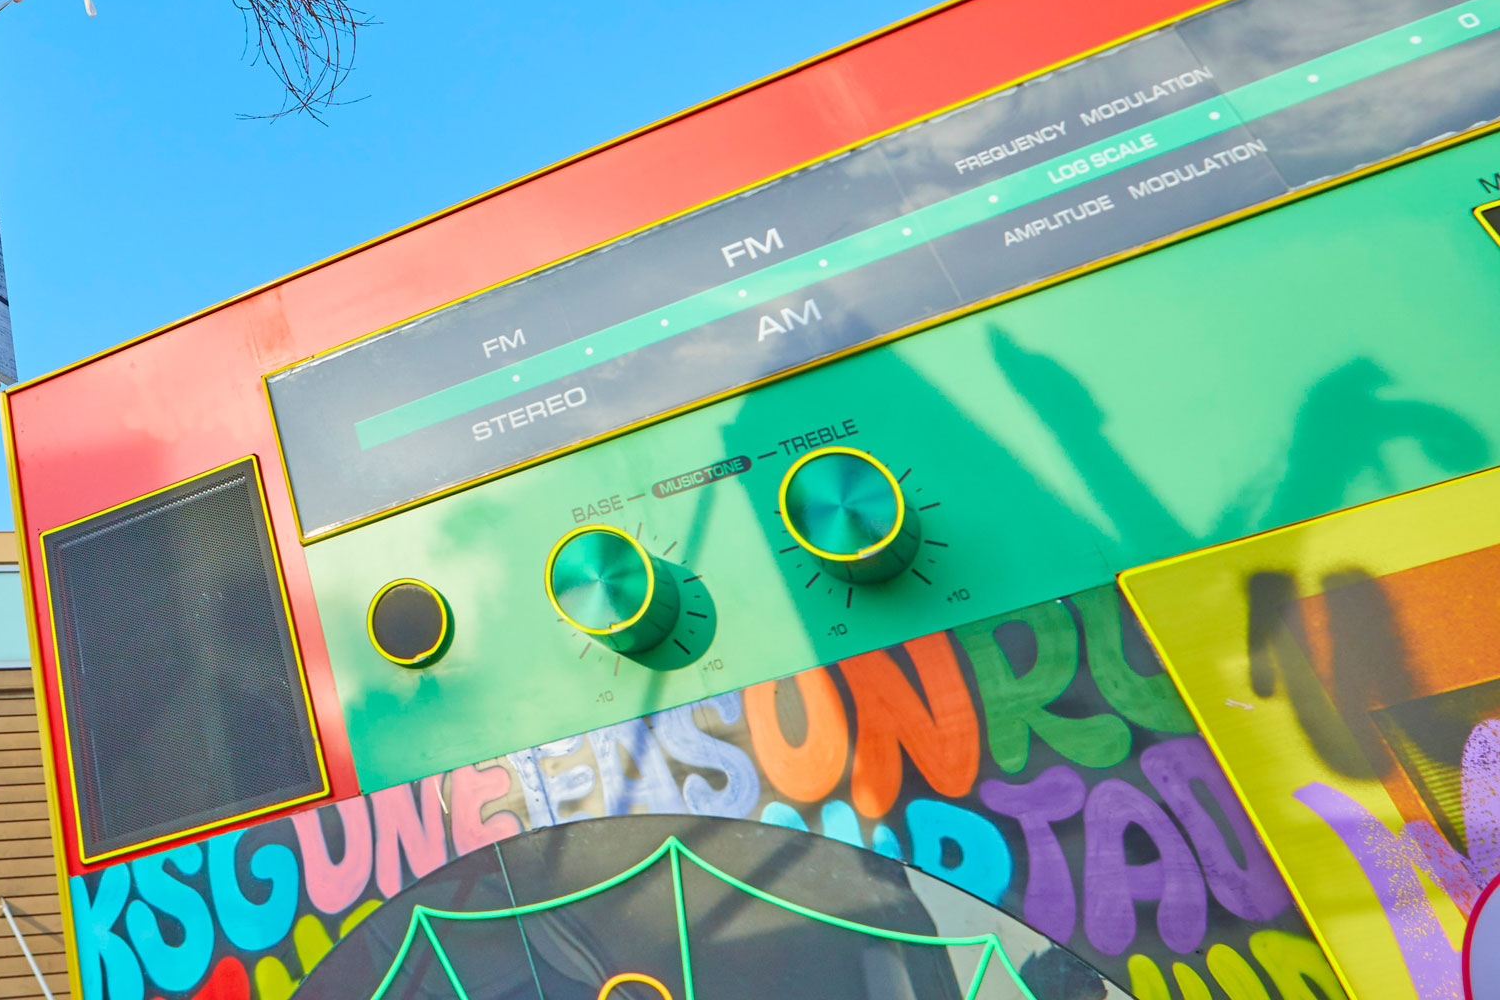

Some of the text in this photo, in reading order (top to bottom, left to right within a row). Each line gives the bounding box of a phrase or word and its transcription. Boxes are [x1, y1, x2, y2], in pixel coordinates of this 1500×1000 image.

[954, 66, 1214, 175] FREQUENCY MODULATION
[1047, 133, 1159, 184] LOG SCALE
[1004, 139, 1269, 247] AMPLITUDE MODULATION
[721, 227, 785, 268] FM
[482, 328, 526, 358] FM
[757, 299, 823, 342] AM
[471, 386, 588, 442] STEREO
[571, 495, 624, 524] BASE
[778, 418, 860, 456] TREBLE
[827, 587, 971, 638] -10 +10
[701, 658, 725, 673] +10
